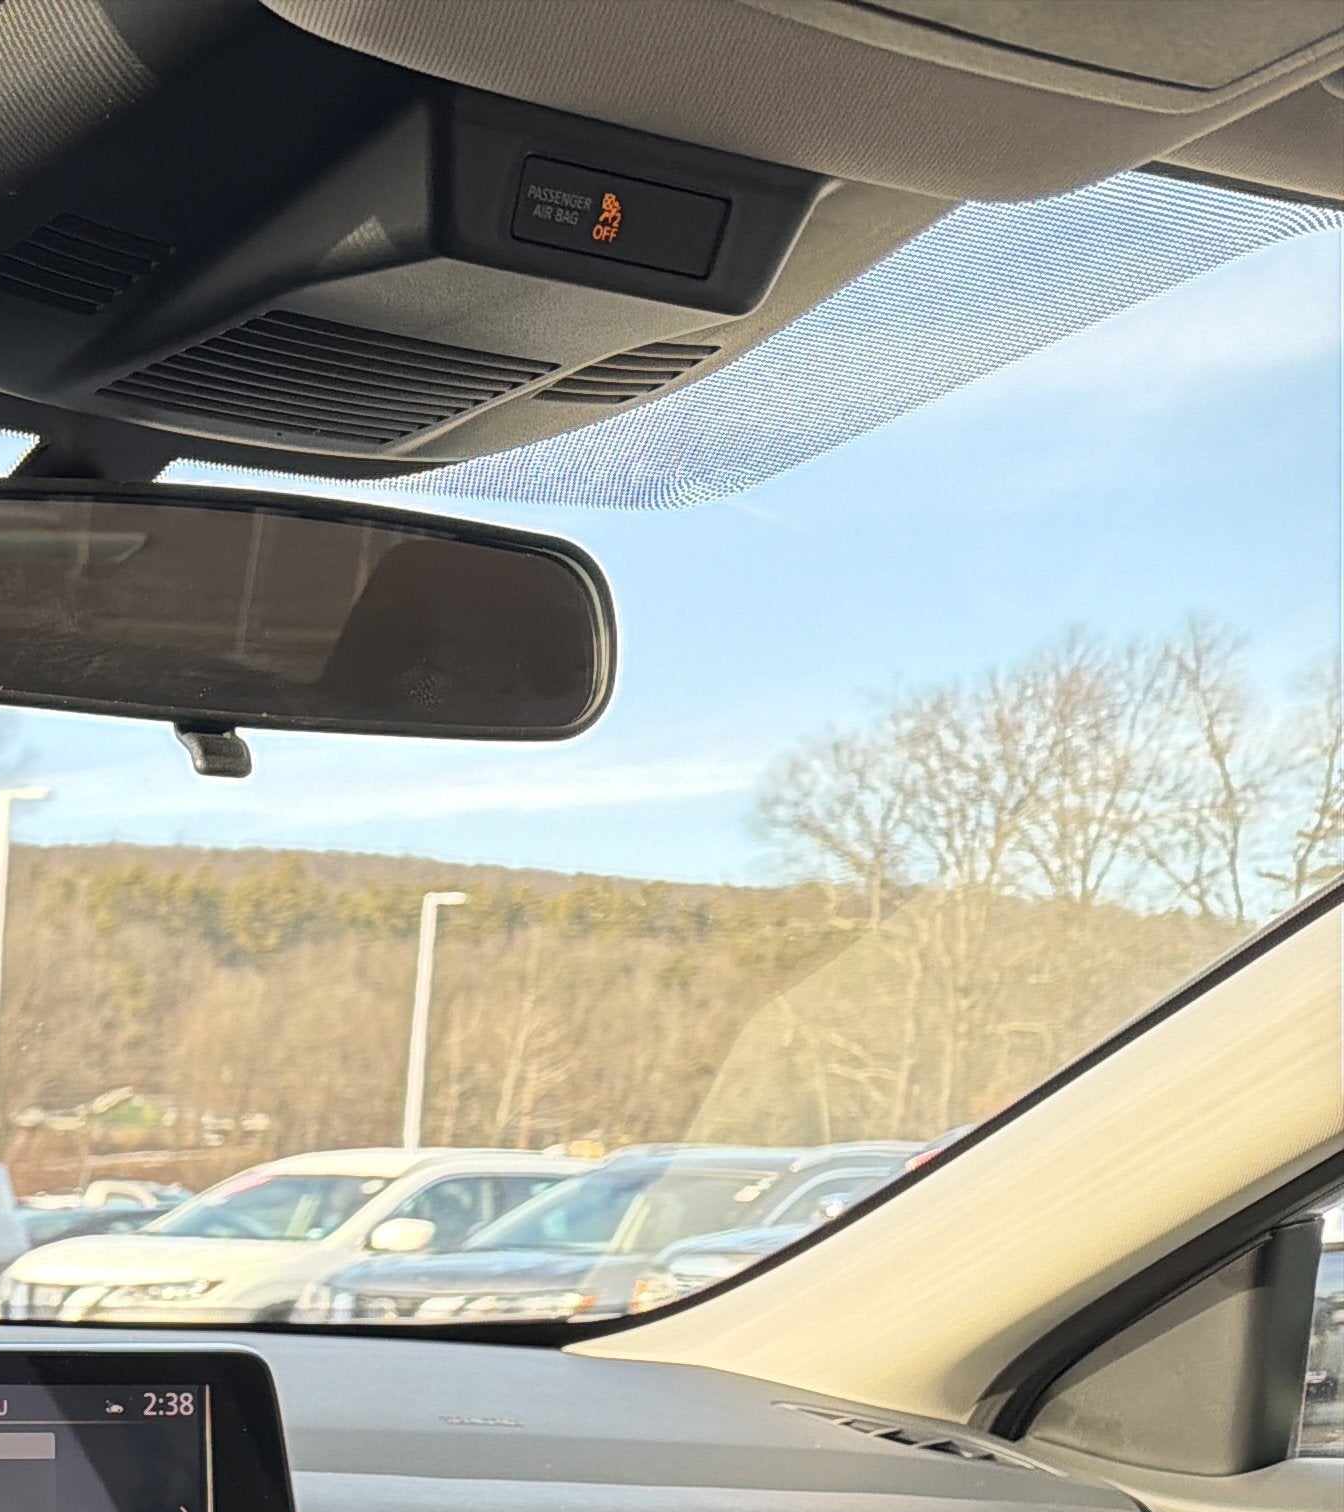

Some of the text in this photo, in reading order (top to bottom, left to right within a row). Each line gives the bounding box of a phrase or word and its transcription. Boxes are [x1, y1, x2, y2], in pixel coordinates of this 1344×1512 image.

[527, 185, 592, 210] PASSENGER
[532, 204, 579, 226] AIR BAG
[592, 224, 618, 243] OFF
[143, 1392, 195, 1417] 2:38
